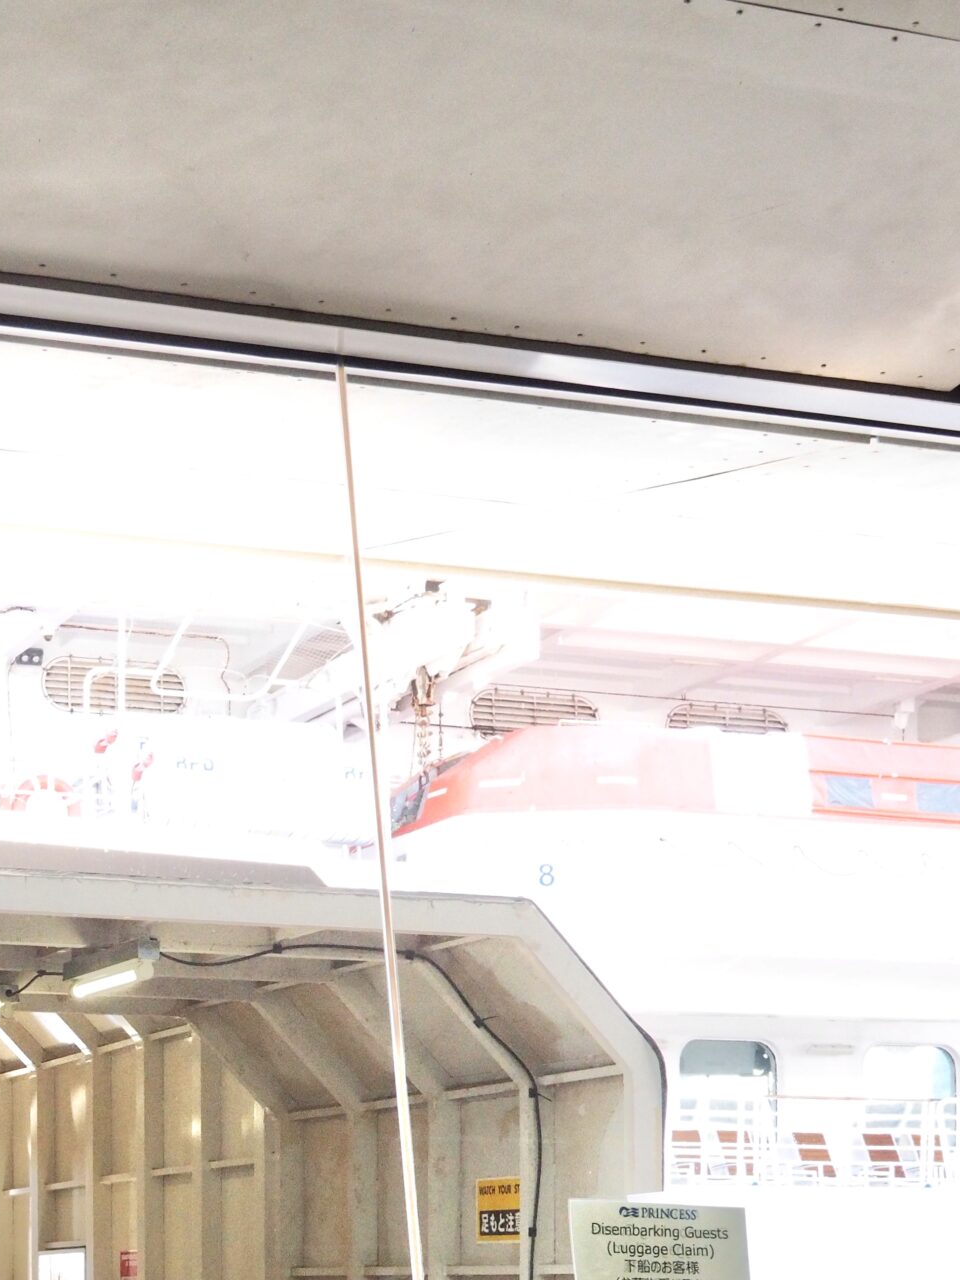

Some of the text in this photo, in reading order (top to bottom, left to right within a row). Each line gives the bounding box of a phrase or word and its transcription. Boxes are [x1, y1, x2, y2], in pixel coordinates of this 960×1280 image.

[538, 863, 555, 887] 8
[498, 1184, 512, 1195] YOUR
[641, 1207, 698, 1221] PRINCESS
[591, 1222, 729, 1241] Disembarking Guests
[607, 1241, 715, 1259] (Luggage Claim)
[624, 1259, 700, 1276] 下船のお客様
